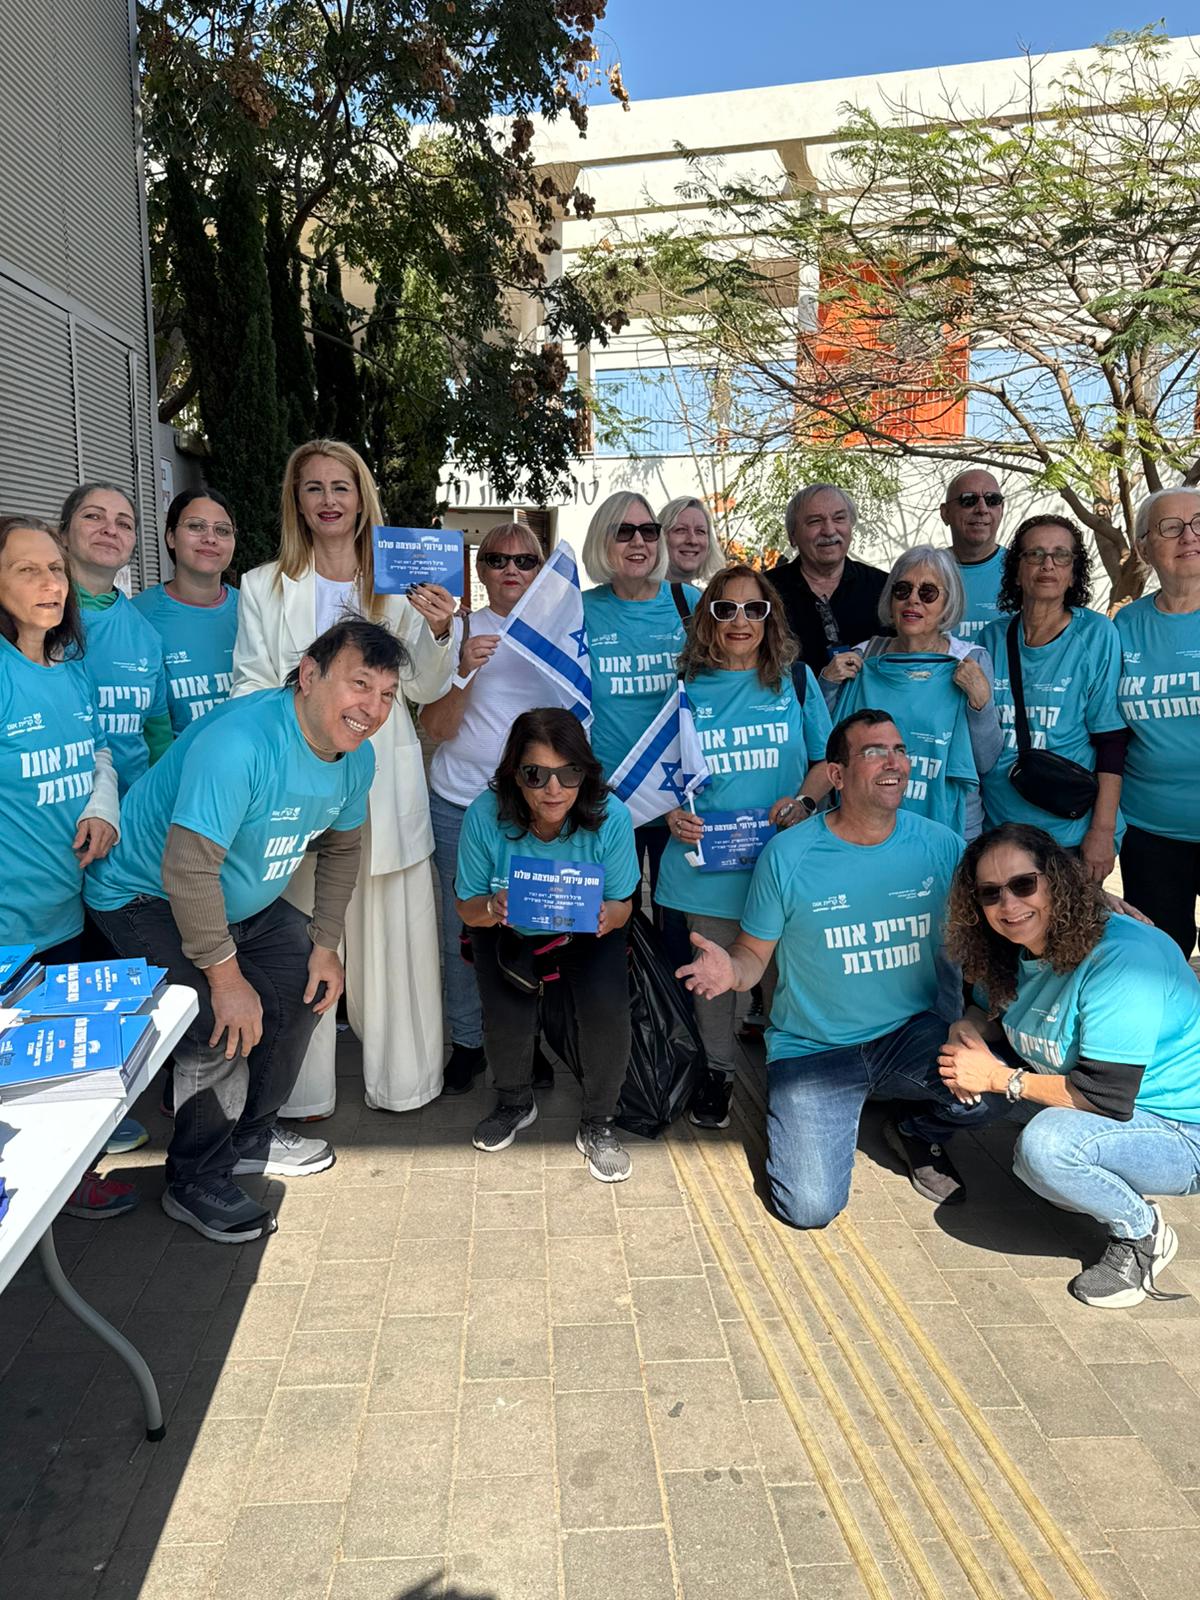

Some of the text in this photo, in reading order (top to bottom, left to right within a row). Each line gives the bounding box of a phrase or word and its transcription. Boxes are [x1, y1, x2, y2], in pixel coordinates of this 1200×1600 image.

[959, 620, 992, 637] יית
[598, 655, 632, 673] אונו
[170, 674, 211, 699] אונו
[1151, 671, 1200, 695] ריית
[98, 685, 151, 711] קריית
[98, 713, 141, 734] מתנד
[732, 722, 789, 746] קריית
[20, 738, 96, 779] ריית אונו
[704, 747, 779, 775] מתנדבת
[906, 754, 943, 780] קרי
[36, 770, 94, 807] תנדבת
[263, 834, 299, 858] אונו
[824, 912, 931, 949] קריית אונו
[842, 942, 921, 975] מתנדבת
